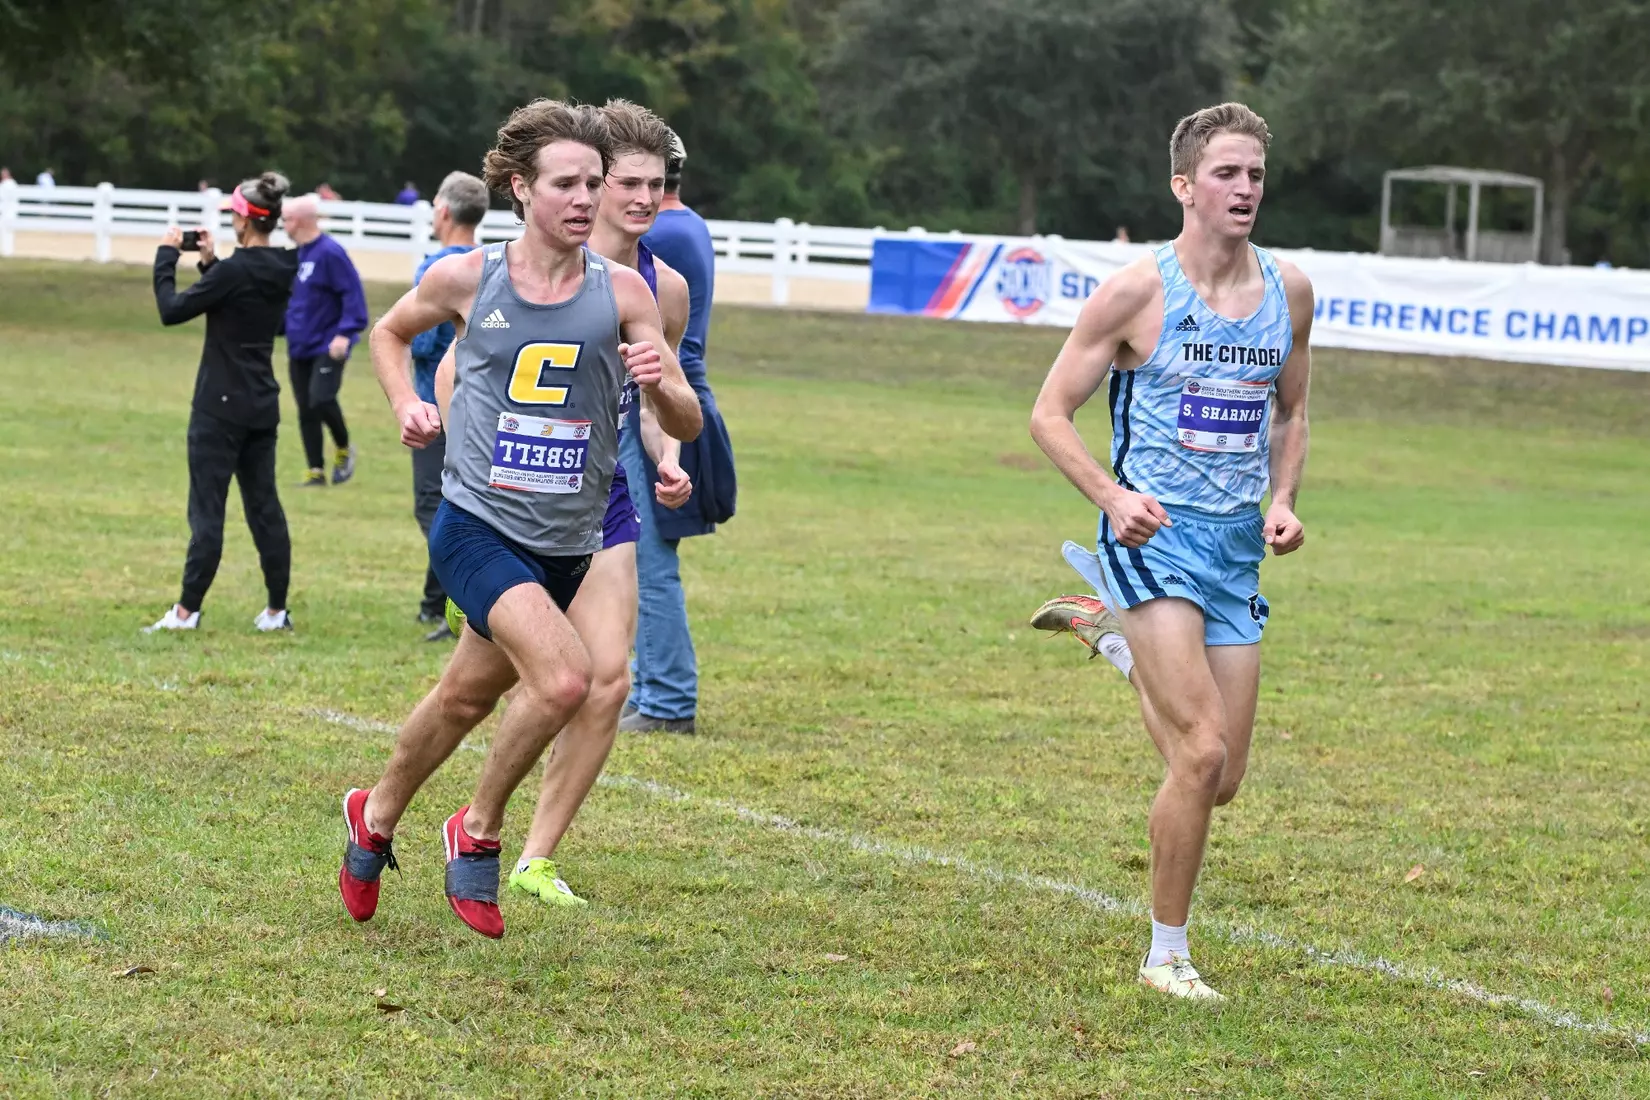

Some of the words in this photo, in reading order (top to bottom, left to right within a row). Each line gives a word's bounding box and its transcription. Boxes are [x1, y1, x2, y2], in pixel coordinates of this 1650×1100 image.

[480, 321, 511, 329] adidas
[1175, 324, 1201, 332] adidas
[1505, 310, 1649, 345] CHAMP
[1182, 342, 1214, 362] THE
[1218, 344, 1282, 367] CITADEL
[505, 340, 585, 407] C
[1183, 403, 1195, 417] S.
[1201, 406, 1263, 422] SHARNAS
[499, 439, 584, 469] ISBELL
